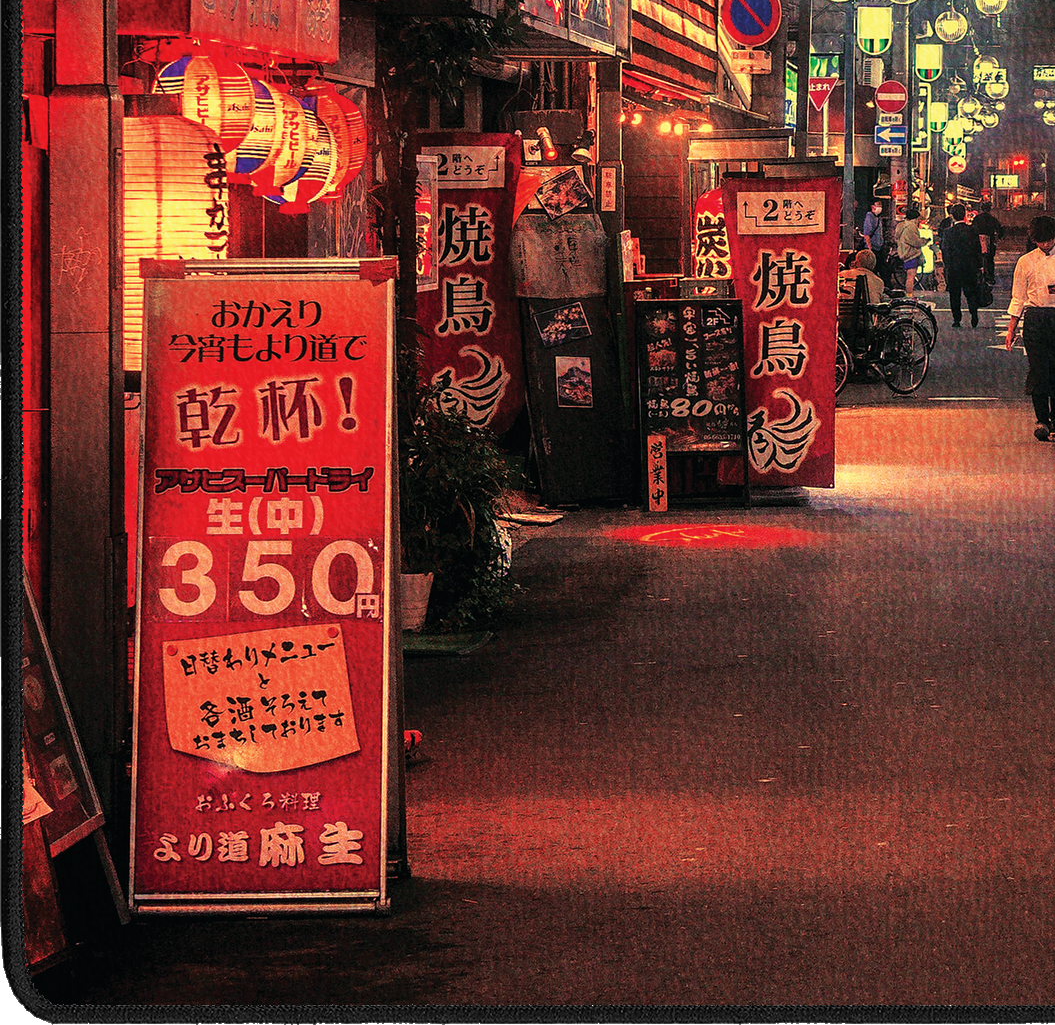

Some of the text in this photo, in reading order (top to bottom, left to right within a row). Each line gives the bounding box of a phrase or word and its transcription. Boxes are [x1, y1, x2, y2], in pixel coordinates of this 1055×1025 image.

[195, 74, 211, 125] アサヒビー
[453, 165, 486, 176] どうぞ
[783, 210, 816, 221] どうぞ
[438, 206, 494, 333] 焼鳥
[211, 299, 322, 328] おかえり
[706, 317, 719, 326] 2F
[753, 252, 811, 377] 焼鳥
[169, 333, 367, 363] 今宵もより道で
[155, 467, 374, 493] アサヒスーパードライ
[206, 495, 324, 535] 生(中)
[180, 641, 336, 677] 日替わりメニュー
[257, 672, 271, 690] と
[193, 712, 345, 750] おまちしております
[195, 792, 322, 812] おふくろ料理
[153, 831, 251, 863] より道
